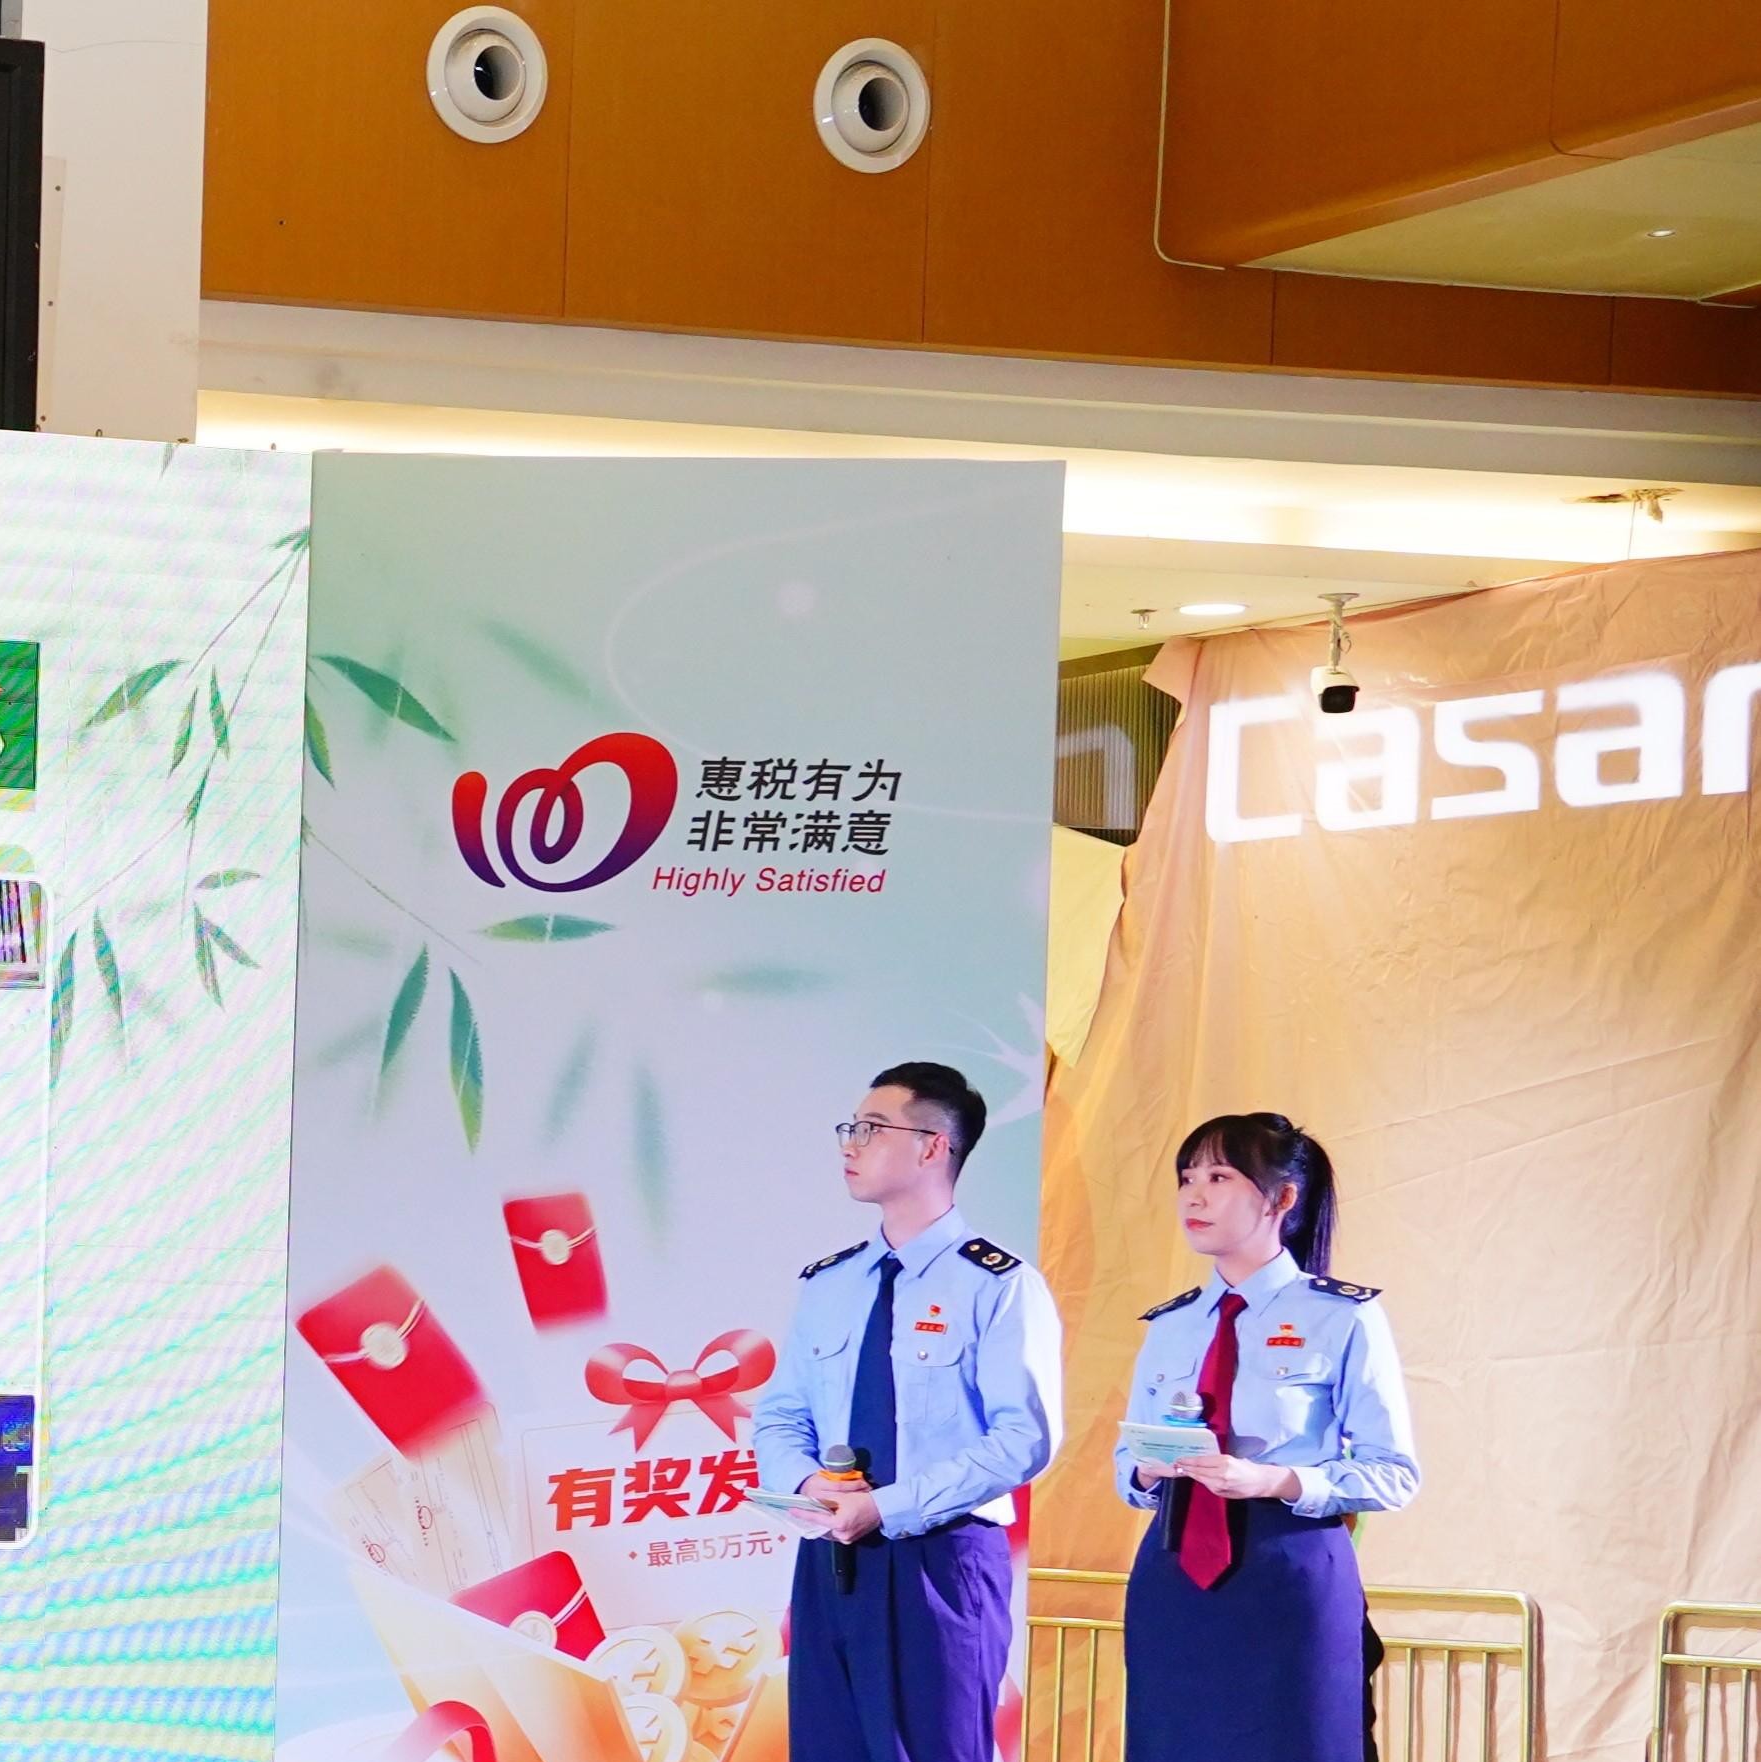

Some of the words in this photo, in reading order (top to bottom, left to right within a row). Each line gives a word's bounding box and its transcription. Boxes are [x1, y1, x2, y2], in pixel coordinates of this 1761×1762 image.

[695, 757, 901, 801] 惠税有为
[686, 809, 891, 855] 非常满意
[652, 866, 745, 896] Highly
[756, 867, 886, 893] Satisfied
[647, 1531, 773, 1567] 最高5万元
